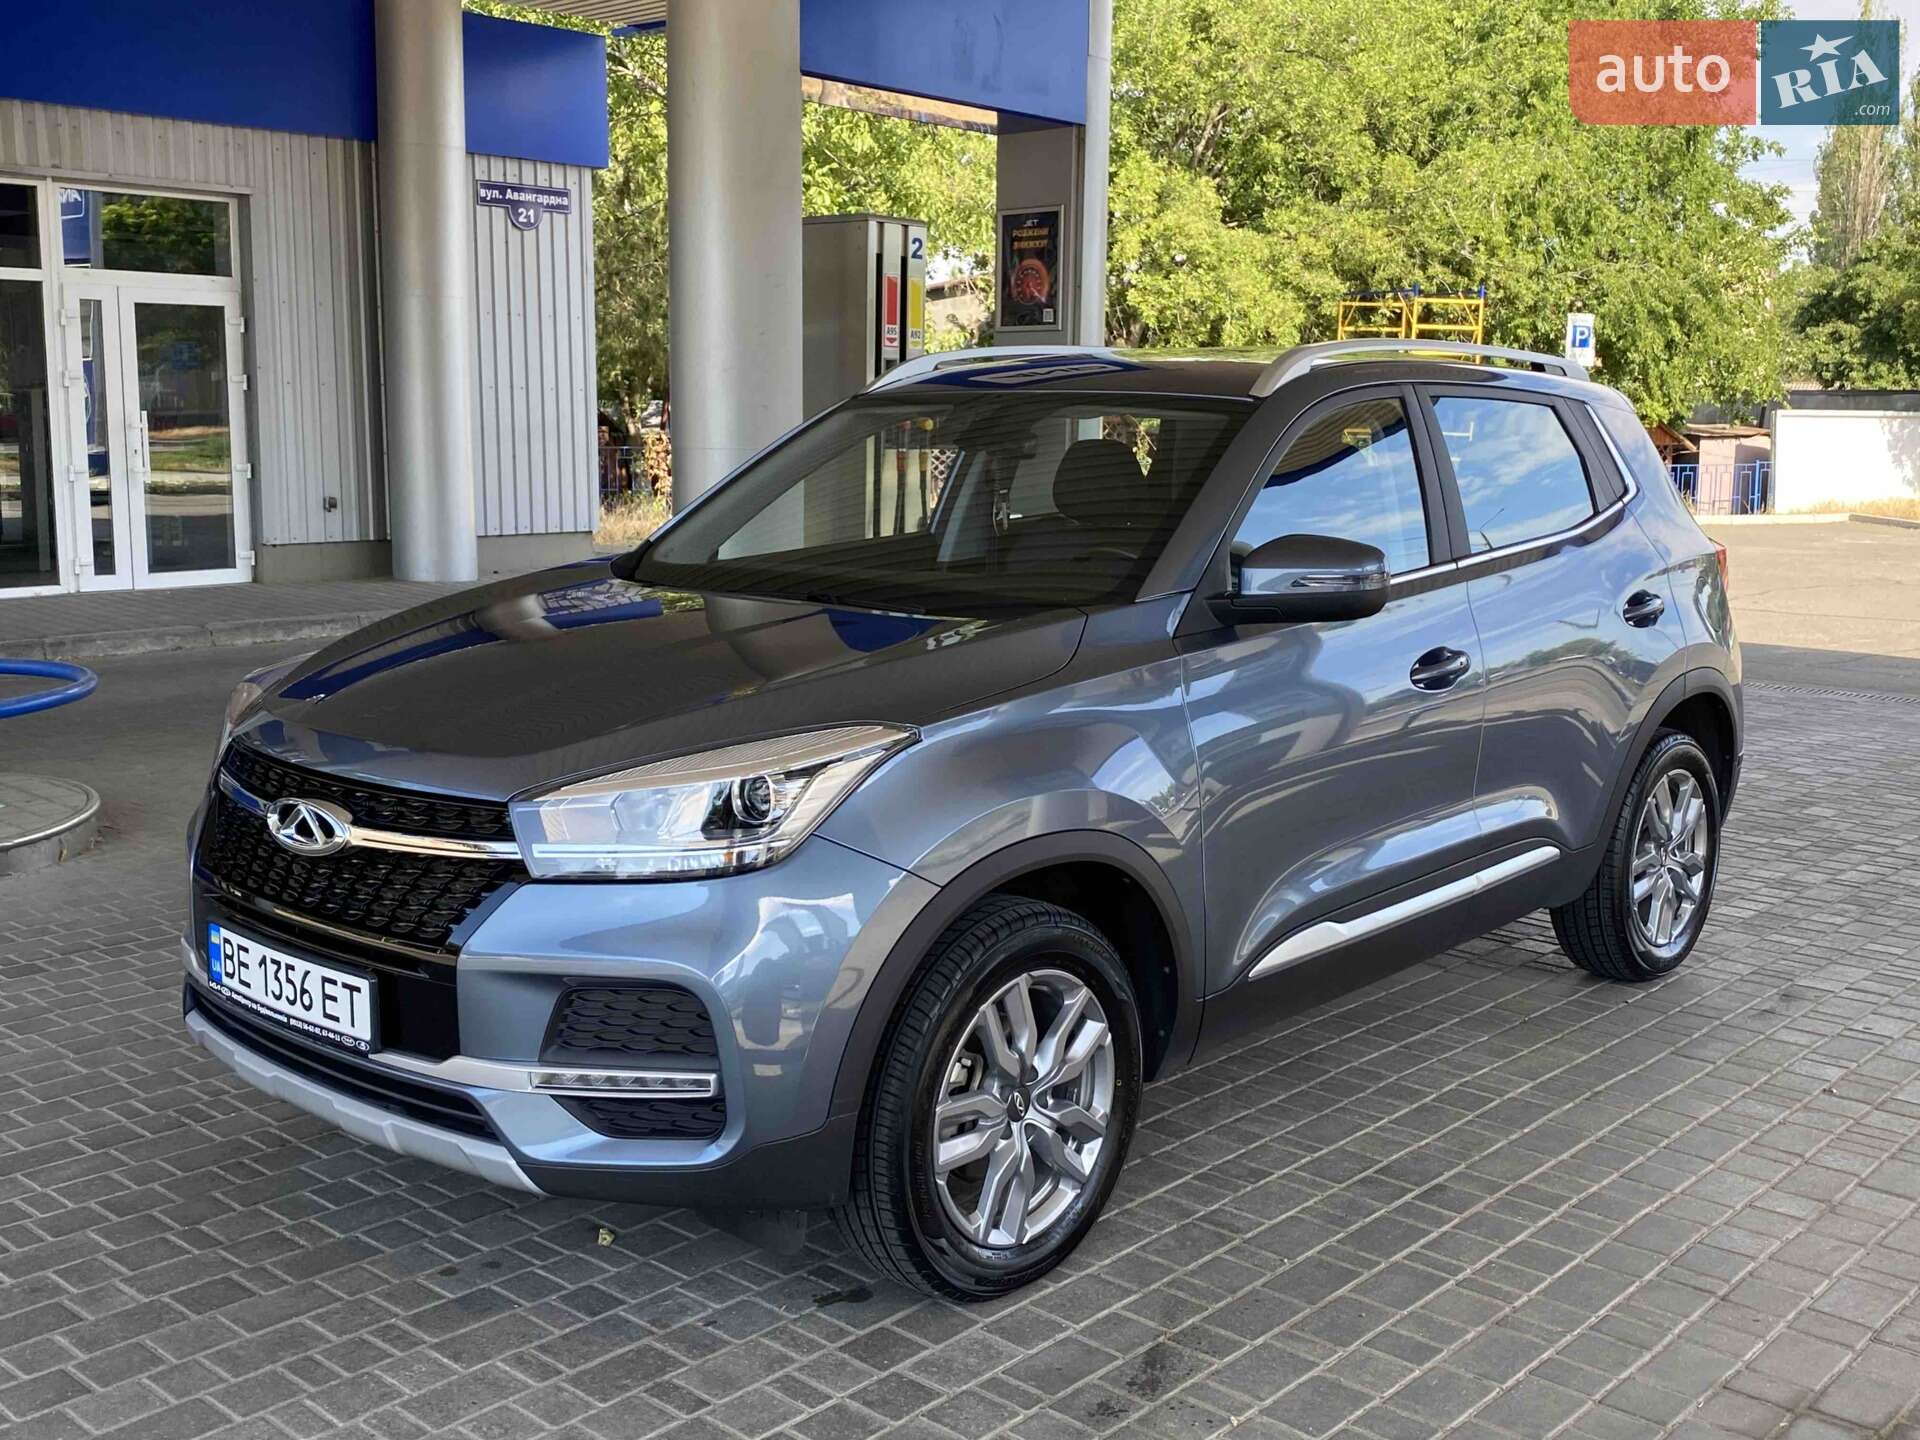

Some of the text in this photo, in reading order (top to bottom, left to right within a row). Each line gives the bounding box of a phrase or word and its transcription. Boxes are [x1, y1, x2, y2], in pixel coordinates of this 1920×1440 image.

[480, 188, 569, 206] вул. Авангардна
[517, 207, 535, 223] 21
[911, 237, 923, 260] 2
[886, 326, 897, 336] A95
[1575, 327, 1589, 347] P
[211, 959, 221, 973] UA
[223, 937, 251, 989] BE
[258, 954, 313, 1012] 1356
[321, 975, 362, 1028] ET
